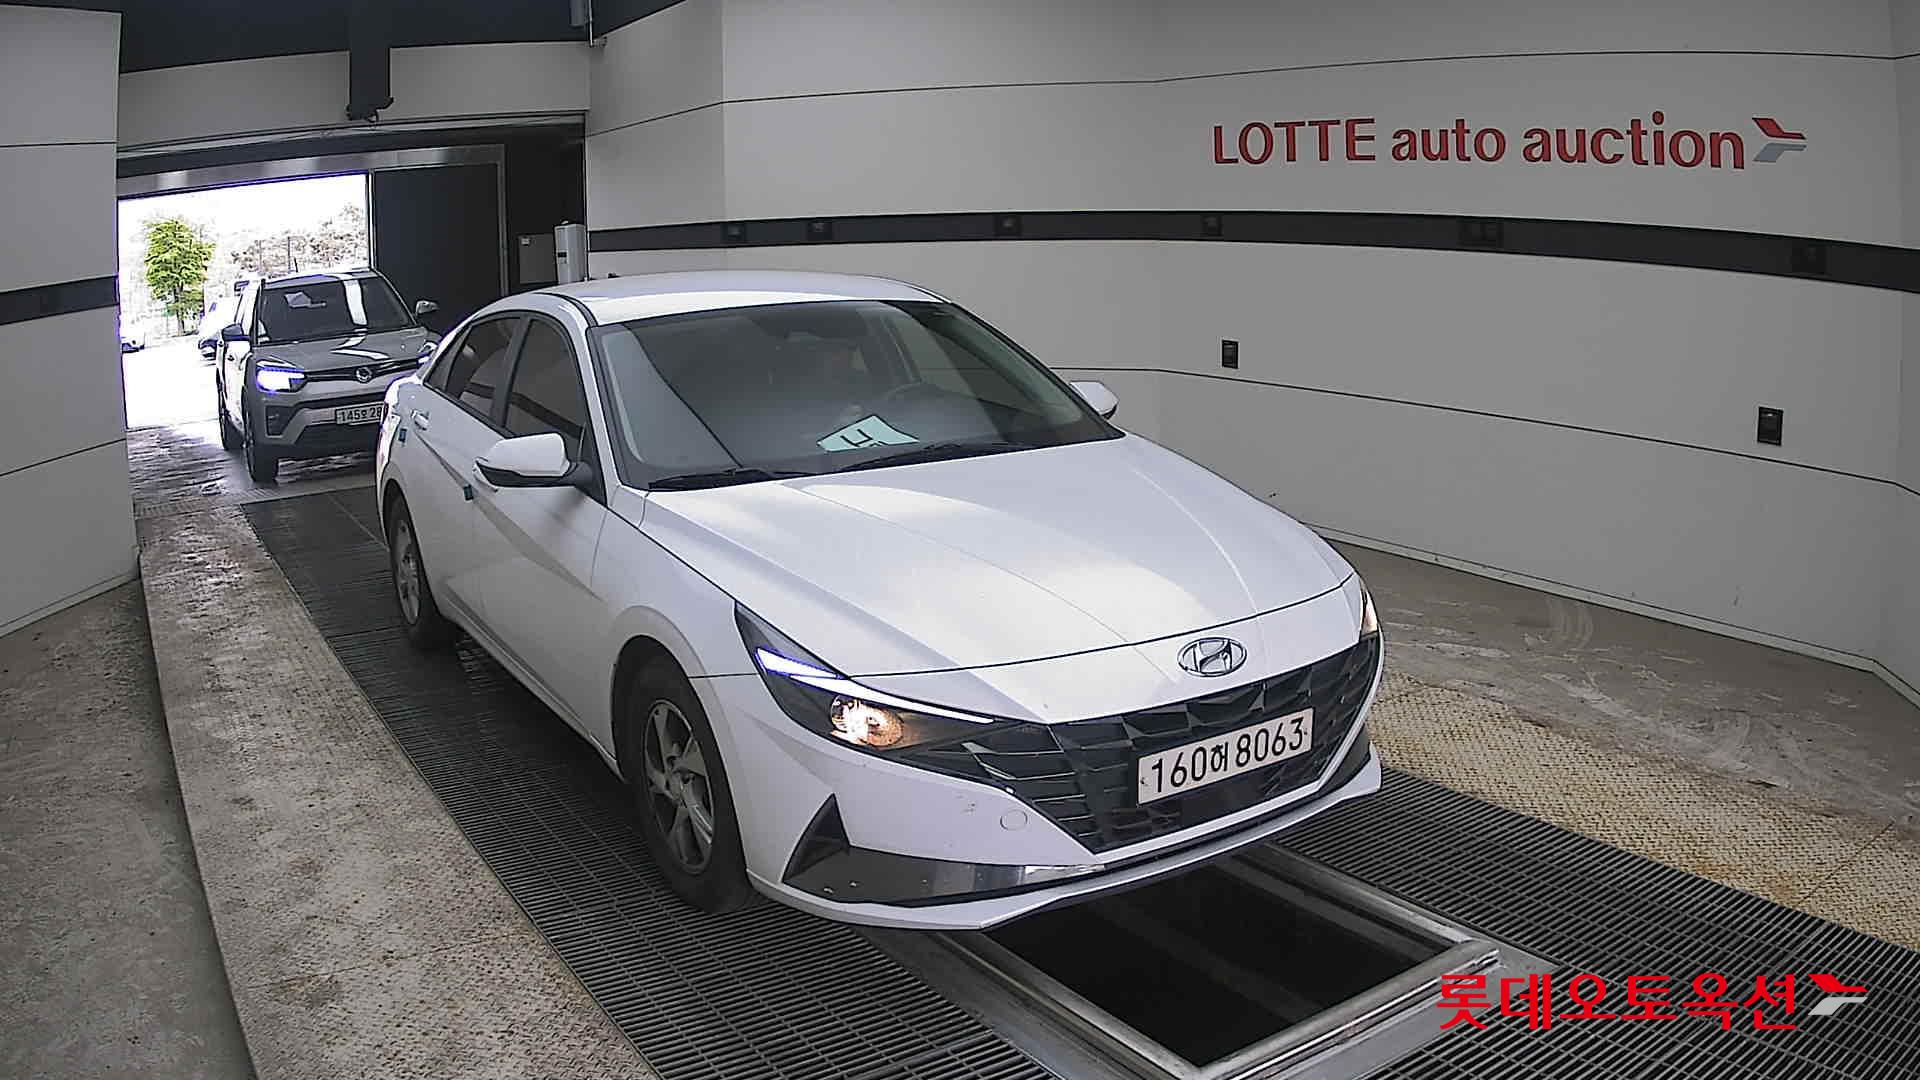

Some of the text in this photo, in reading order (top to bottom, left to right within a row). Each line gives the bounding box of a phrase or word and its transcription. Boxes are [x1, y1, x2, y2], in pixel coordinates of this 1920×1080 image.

[1213, 111, 1745, 170] LOTTE auto auction
